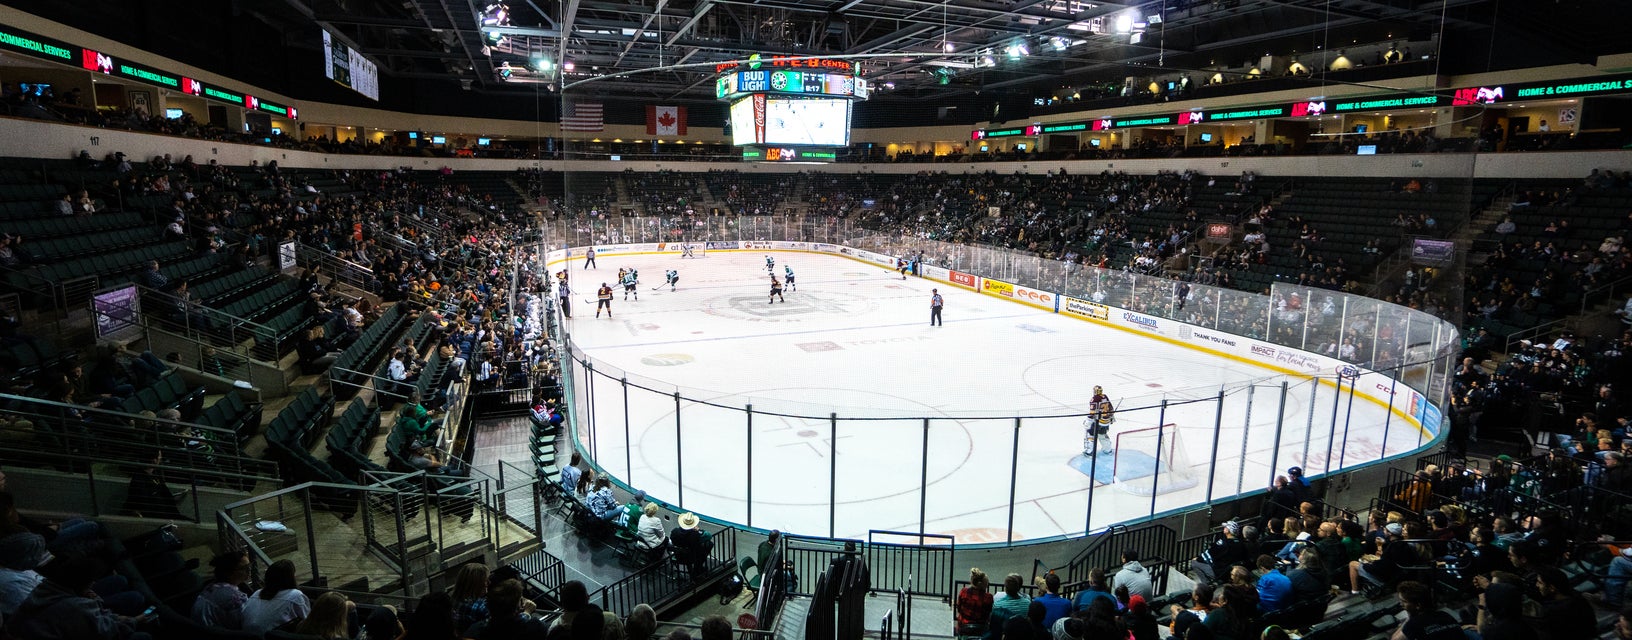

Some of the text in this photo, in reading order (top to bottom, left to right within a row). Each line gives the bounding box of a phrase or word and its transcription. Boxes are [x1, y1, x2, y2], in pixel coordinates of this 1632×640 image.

[0, 32, 71, 59] COMMERCIAL SERVICES
[822, 59, 850, 69] CENTER
[744, 71, 764, 81] BUD
[742, 81, 766, 91] LIGHT
[1518, 88, 1545, 97] HOME
[1546, 87, 1554, 95] &
[1555, 81, 1623, 94] COMMERCIAL
[1336, 103, 1354, 111] HOME
[1360, 99, 1403, 109] COMMERCIAL
[1404, 96, 1437, 106] SERVICES
[1229, 110, 1259, 119] COMMERCIAL
[1259, 108, 1282, 117] SERVICES
[90, 136, 99, 146] 117
[766, 148, 780, 160] ABC
[1194, 332, 1210, 341] THANK
[1221, 338, 1237, 347] FANS!
[1251, 345, 1275, 356] IMPACT
[1376, 383, 1397, 395] CC
[619, 512, 630, 528] 15
